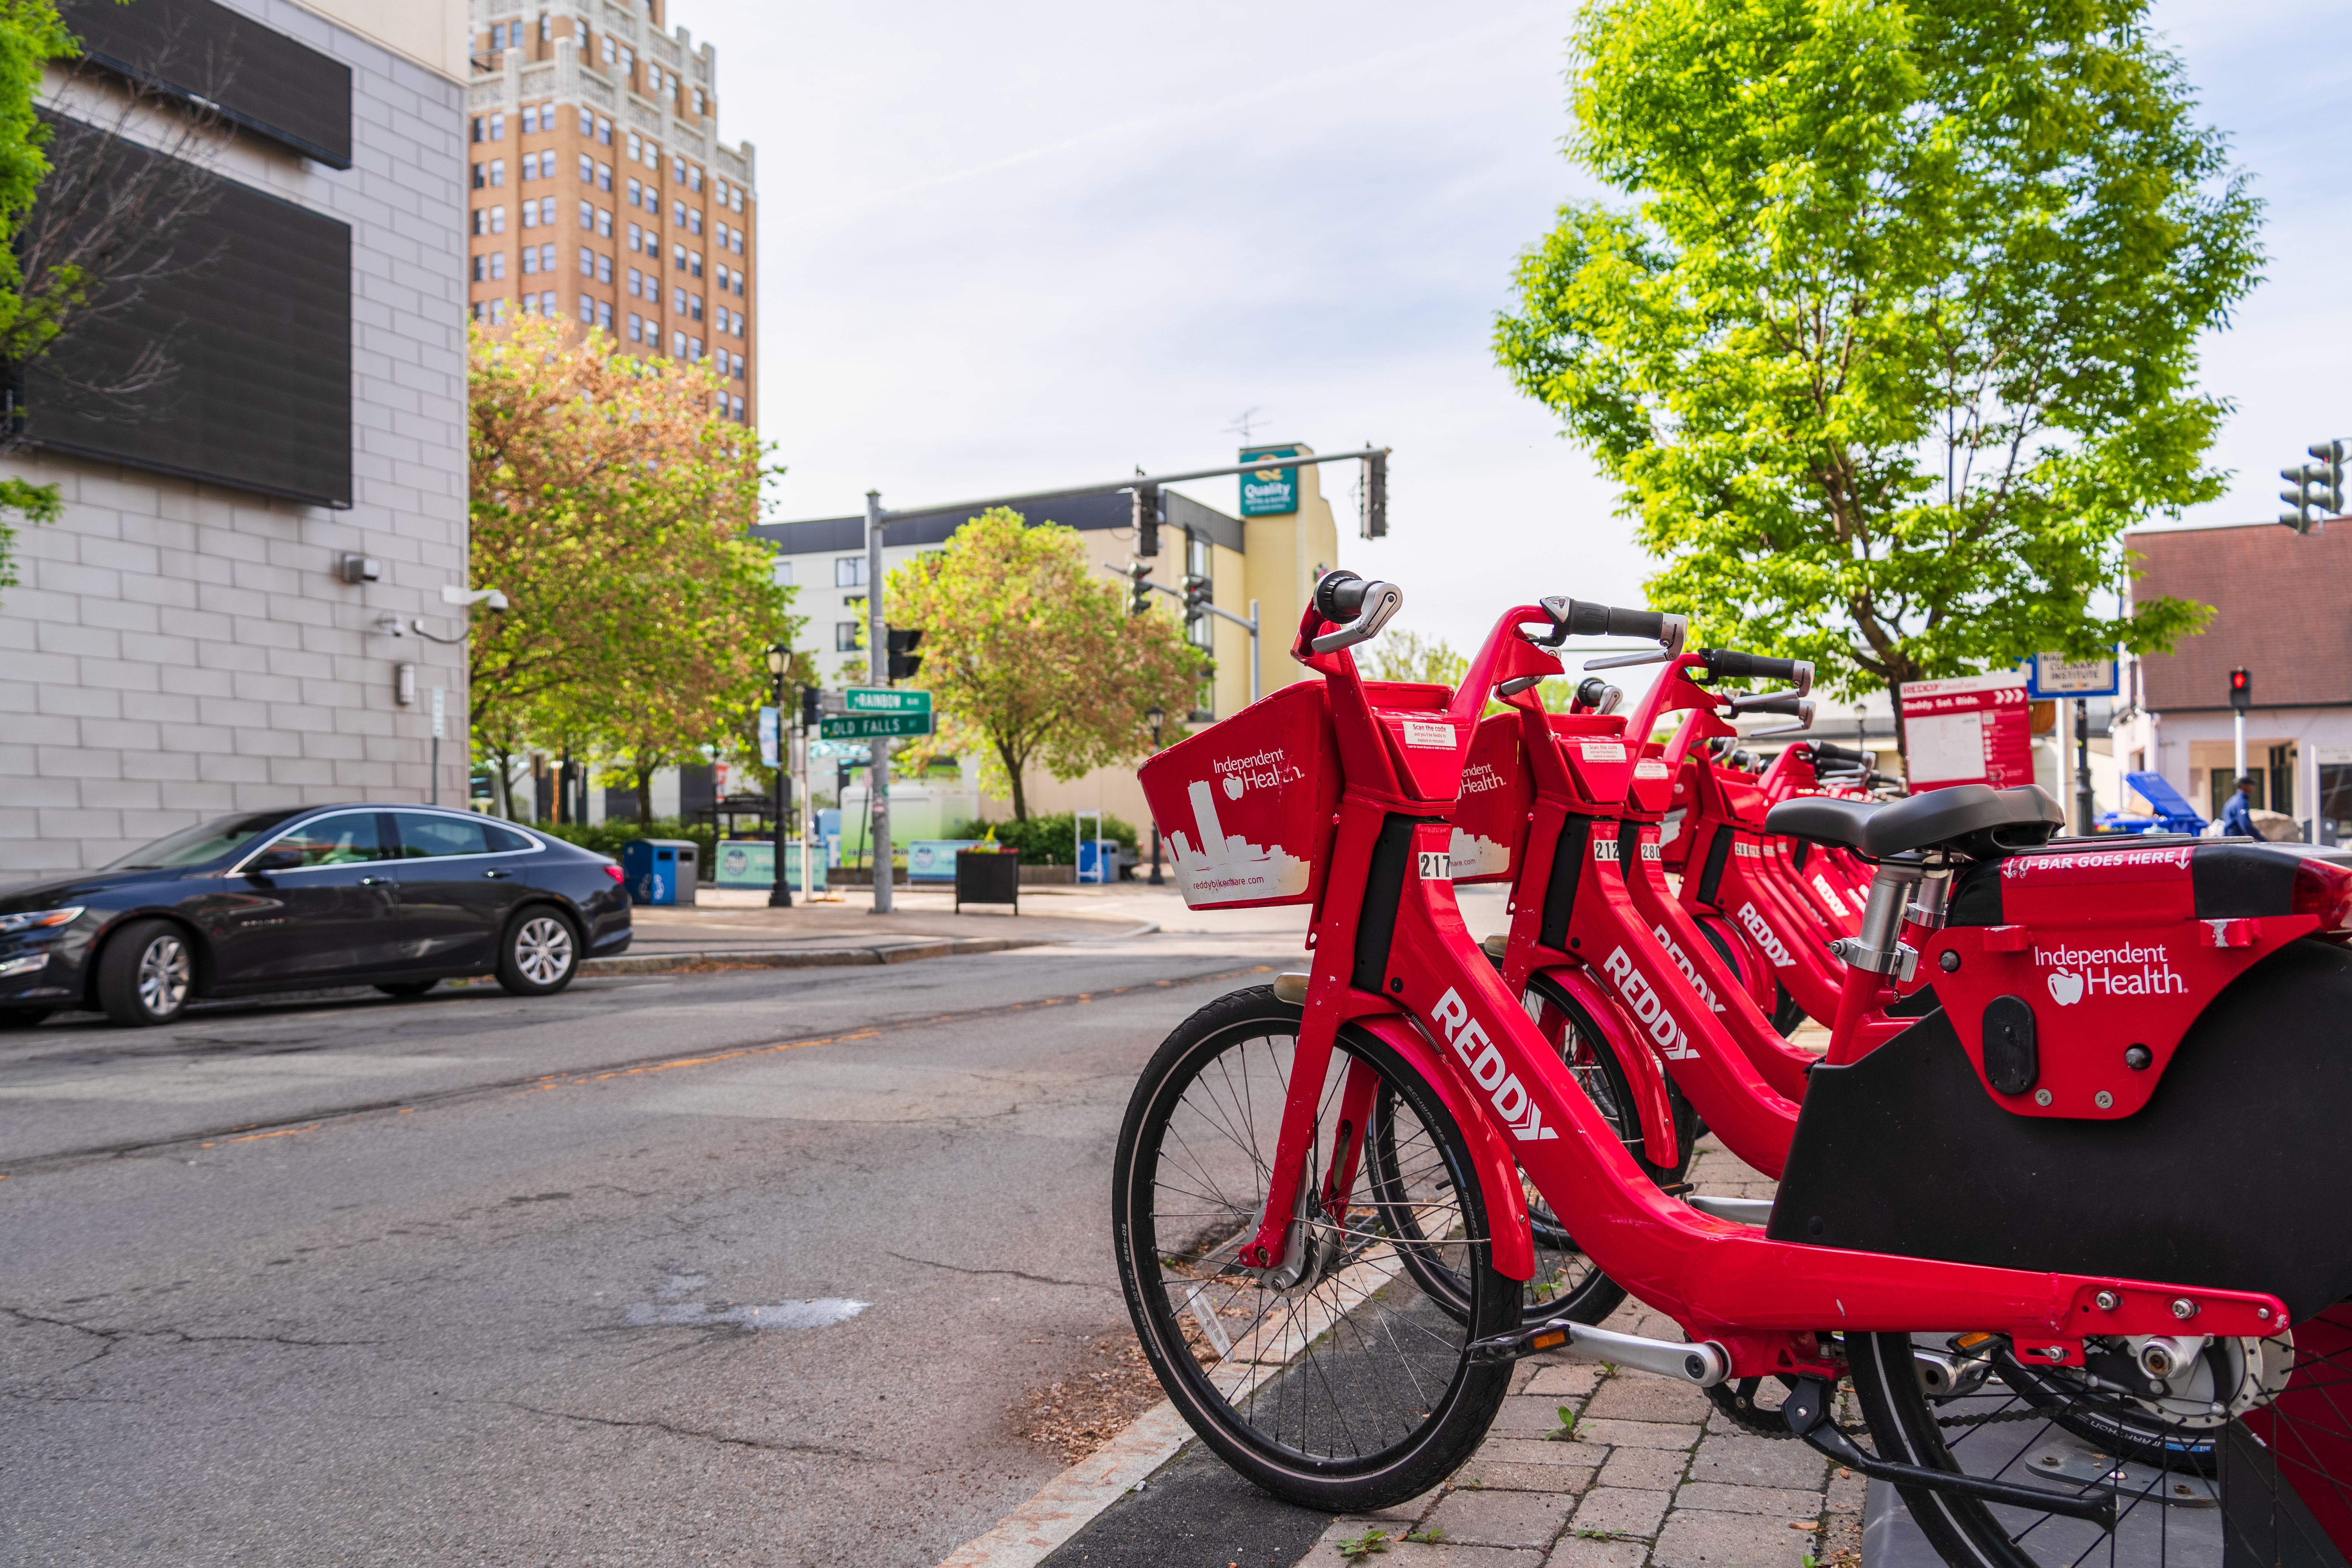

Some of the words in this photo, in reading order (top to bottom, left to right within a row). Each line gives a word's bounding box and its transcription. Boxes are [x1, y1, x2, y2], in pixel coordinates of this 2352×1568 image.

[1245, 482, 1291, 498] Quality
[2052, 670, 2098, 680] INSTITUTE
[859, 693, 901, 708] RAINBOW
[833, 721, 855, 735] OLD
[863, 718, 900, 733] FALLS
[1213, 748, 1284, 775] Independent
[1462, 763, 1492, 777] endent
[1461, 773, 1504, 794] Health
[1596, 842, 1619, 858] 212
[1643, 845, 1660, 858] 280
[2019, 858, 2072, 871] U-BAR
[2078, 854, 2123, 867] GOES
[2129, 851, 2175, 865] HERE
[1421, 854, 1450, 877] 217
[1812, 874, 1850, 917] REDDY
[1738, 902, 1797, 967] REDDY
[2035, 942, 2168, 971] Independent
[2087, 964, 2183, 995] Health
[1603, 945, 1700, 1060] REDDY
[1431, 986, 1559, 1140] REDDY
[1406, 1086, 1446, 1141] SCHWALBE
[1128, 1269, 1138, 1302] 26x2.00
